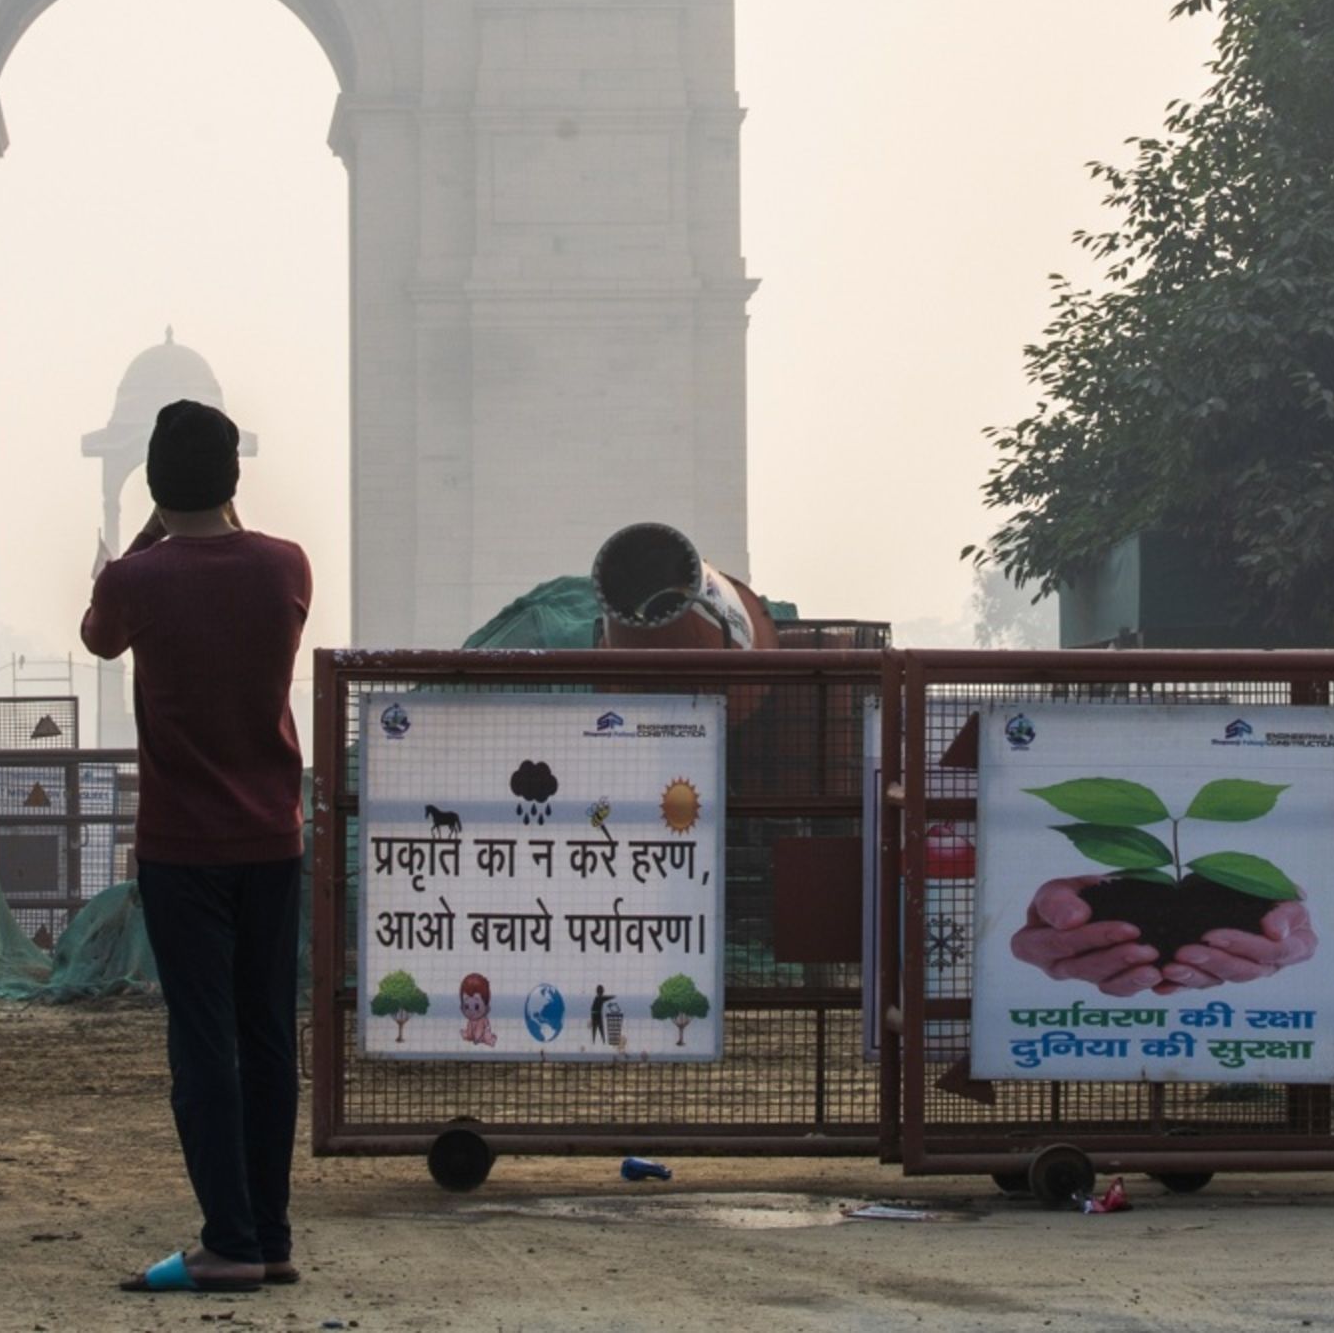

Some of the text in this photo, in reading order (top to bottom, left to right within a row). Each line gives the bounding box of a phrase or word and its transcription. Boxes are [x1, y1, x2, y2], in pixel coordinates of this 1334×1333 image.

[473, 838, 516, 878] का
[528, 839, 555, 878] न
[566, 823, 619, 880] करे
[375, 896, 456, 952] आओ
[467, 898, 553, 953] बचाये
[1009, 1000, 1317, 1029] पर्यावरण की रक्षा
[1010, 1030, 1317, 1068] दुनिया की सुरक्षा
